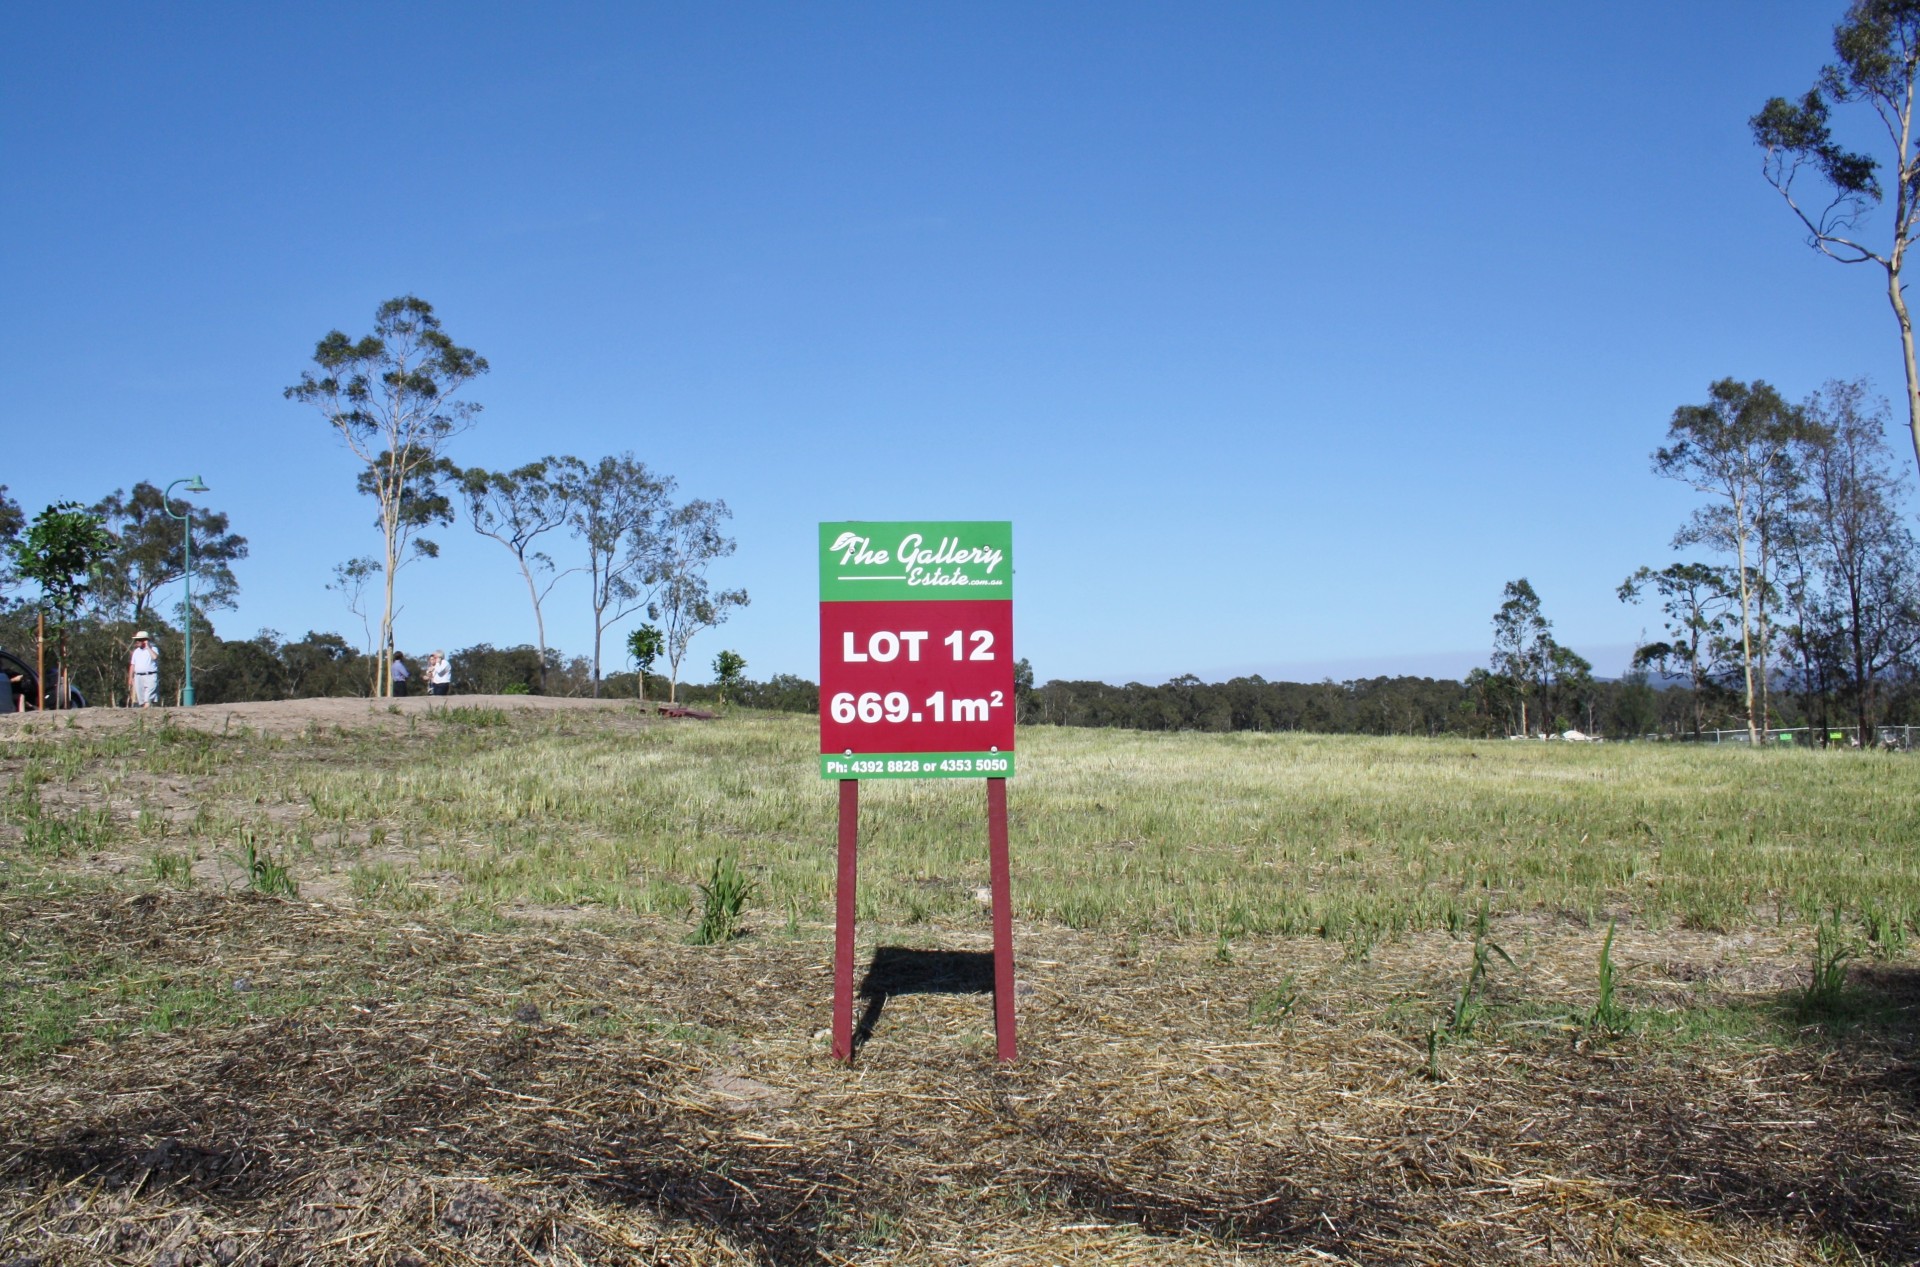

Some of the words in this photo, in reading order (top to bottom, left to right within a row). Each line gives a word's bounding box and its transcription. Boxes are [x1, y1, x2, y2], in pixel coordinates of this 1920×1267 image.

[830, 532, 889, 566] The
[898, 533, 1003, 574] Gallery
[843, 631, 928, 663] LOT
[944, 630, 995, 661] 12
[830, 690, 1004, 724] 669.1m²
[827, 762, 848, 773] Ph:
[851, 761, 883, 773] 4392
[887, 760, 919, 772] 8828
[923, 762, 937, 771] or
[940, 760, 972, 772] 4353
[975, 759, 1008, 771] 5050
